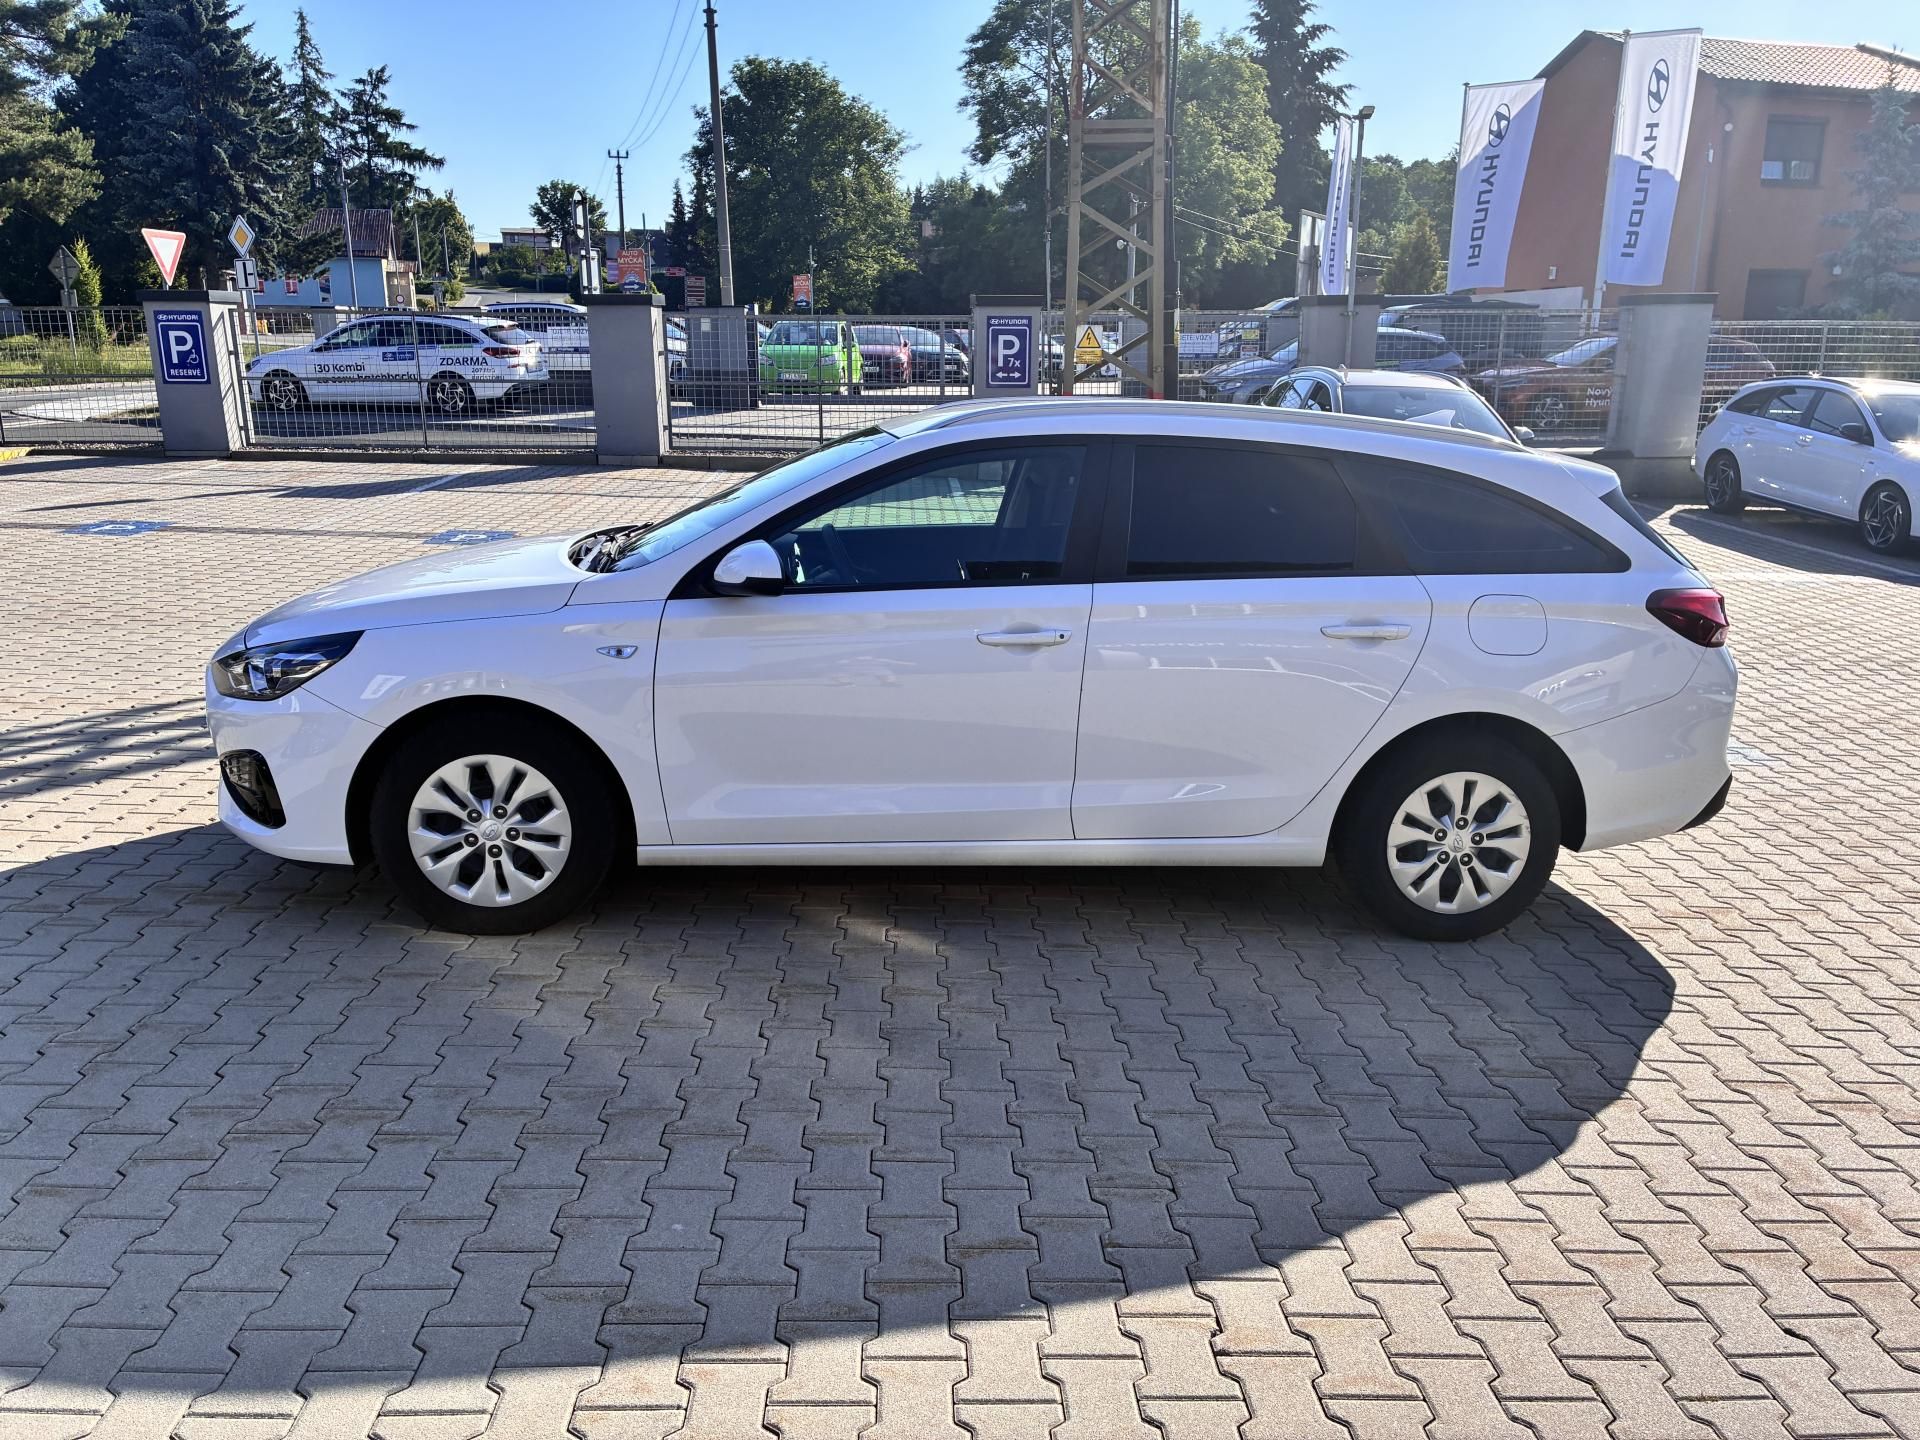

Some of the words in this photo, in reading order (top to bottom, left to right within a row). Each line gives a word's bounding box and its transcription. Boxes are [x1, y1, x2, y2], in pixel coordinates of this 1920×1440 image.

[1620, 122, 1660, 258] HYUNDAI
[1467, 153, 1501, 268] HYUNDAI
[168, 330, 194, 364] P
[998, 335, 1020, 367] P
[170, 368, 202, 376] RESERVÉ
[314, 363, 330, 373] i30
[333, 361, 366, 373] Kombi
[440, 356, 489, 366] ZDARMA
[1008, 357, 1021, 368] 7x
